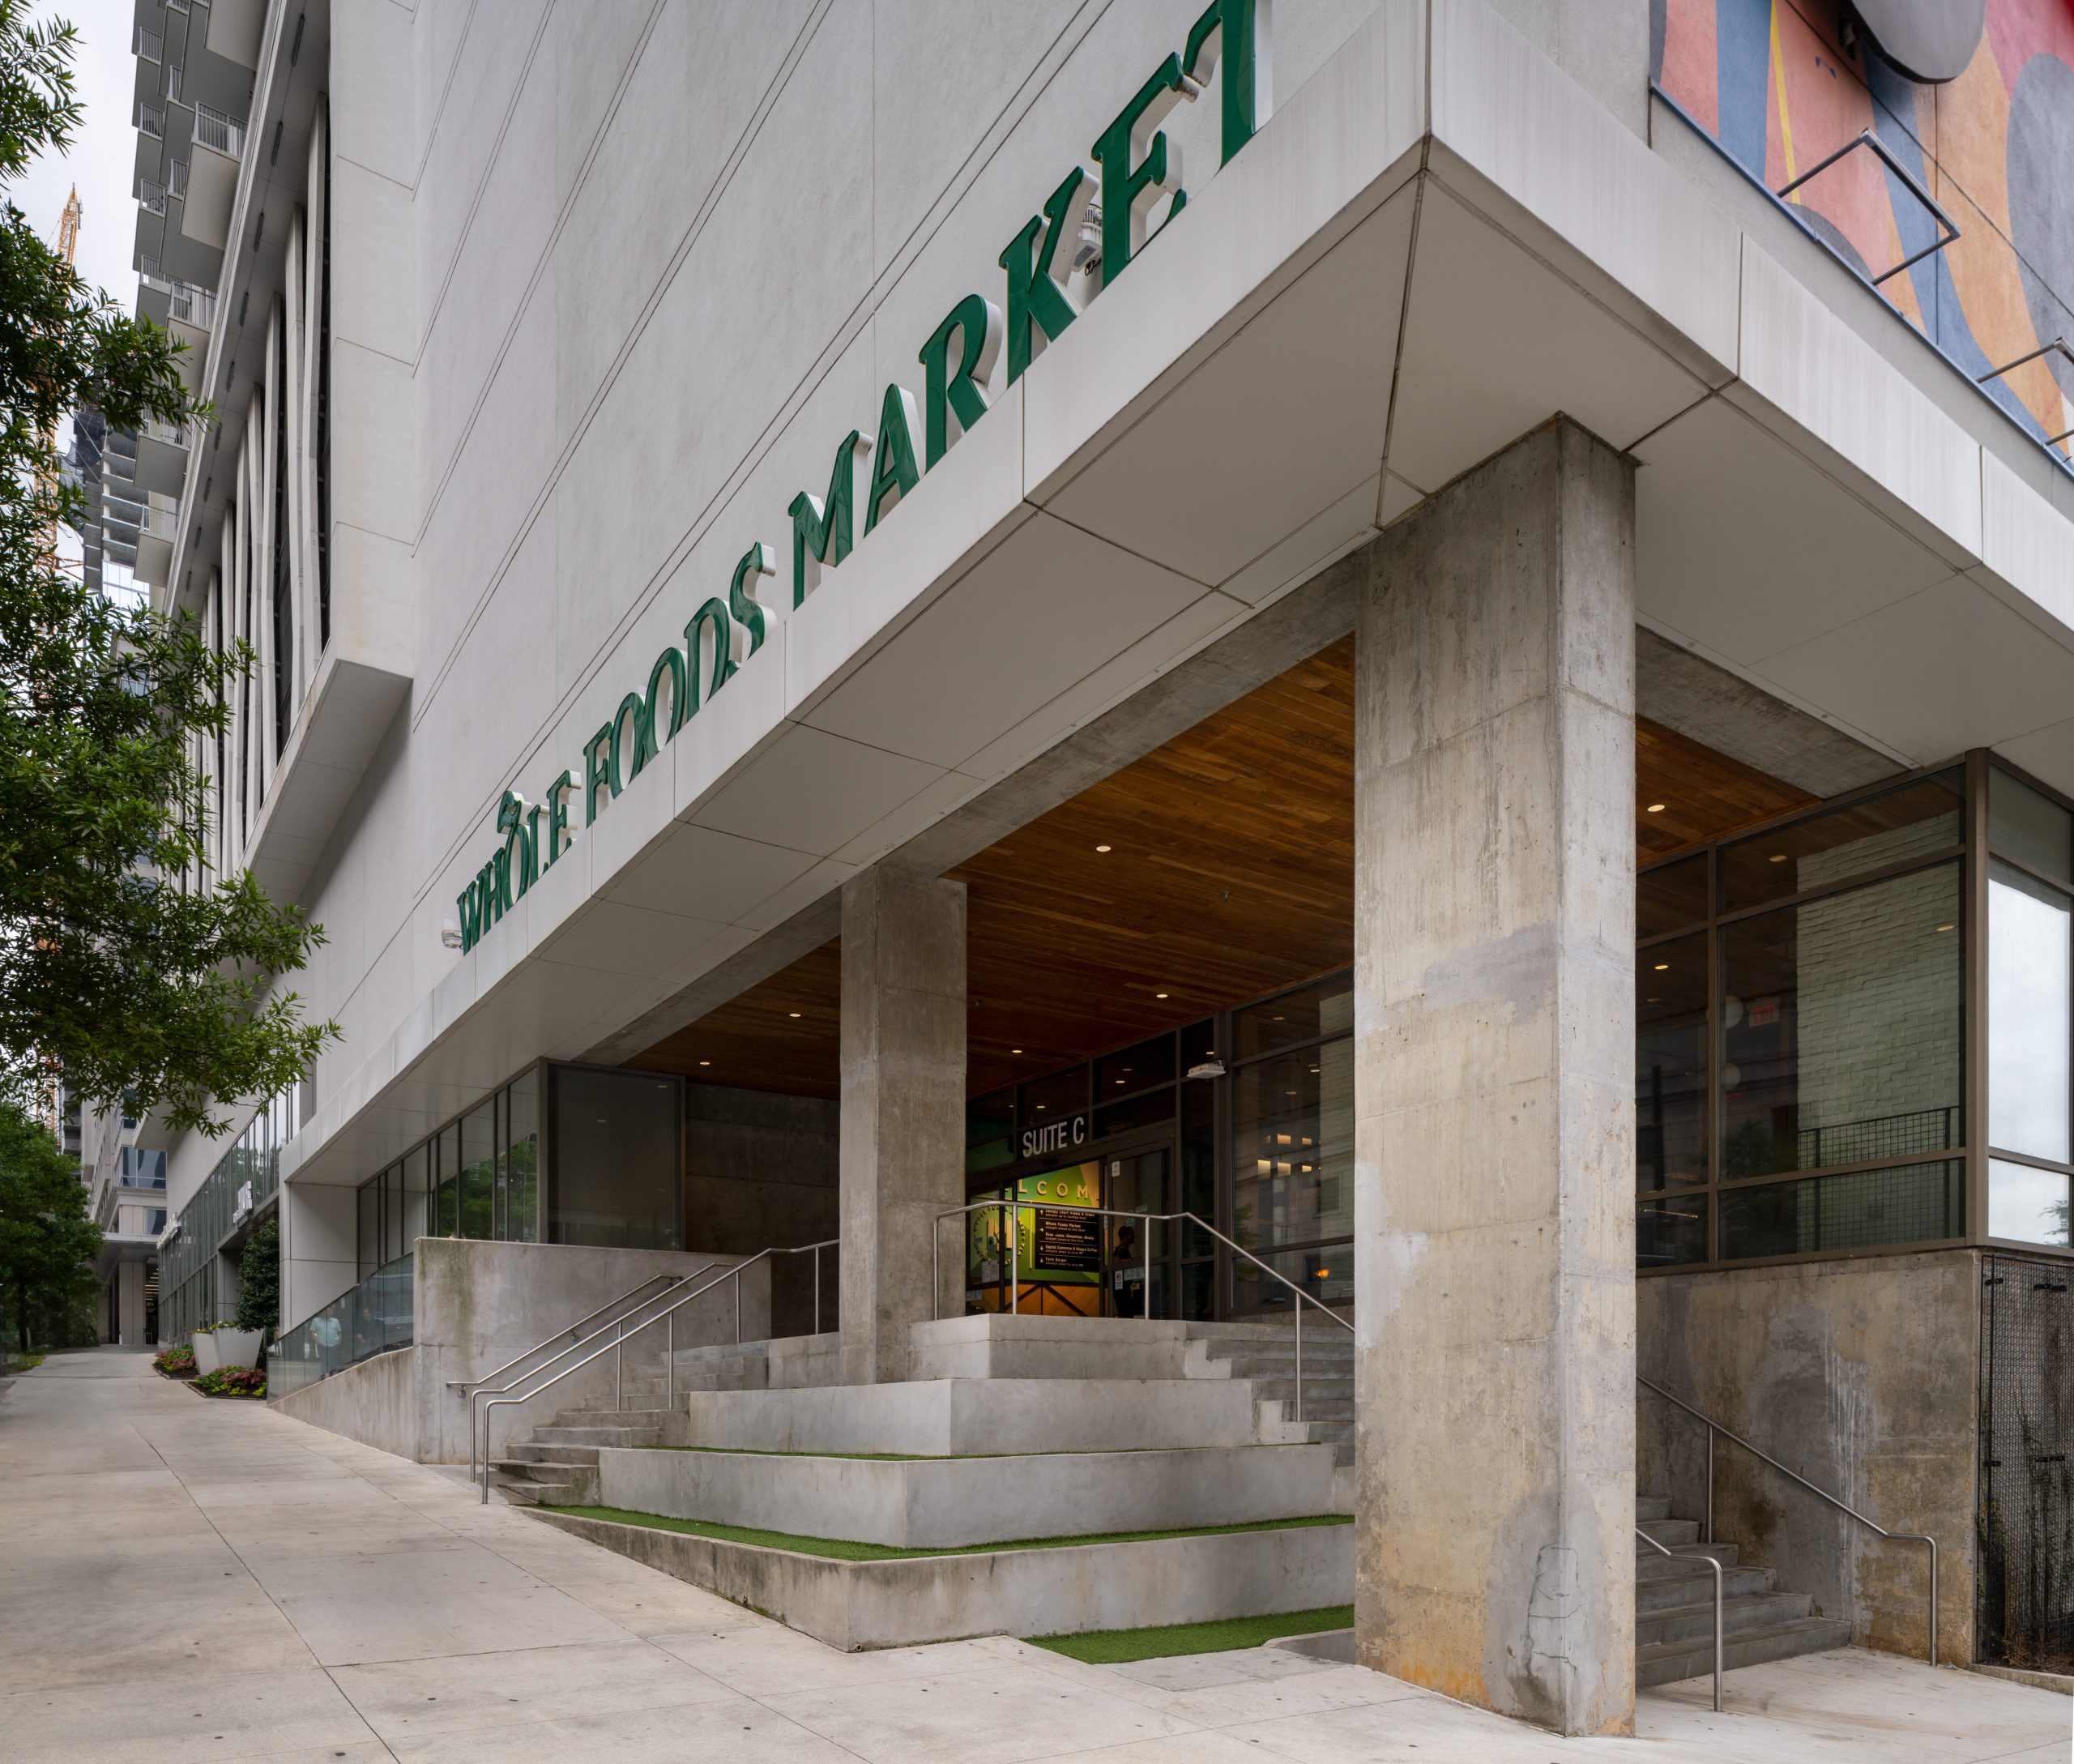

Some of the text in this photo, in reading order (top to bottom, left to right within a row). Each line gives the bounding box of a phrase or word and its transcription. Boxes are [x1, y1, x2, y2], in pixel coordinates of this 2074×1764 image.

[456, 0, 1262, 955] WHOLE FOODS MARKET
[1022, 1117, 1085, 1158] SUITE C
